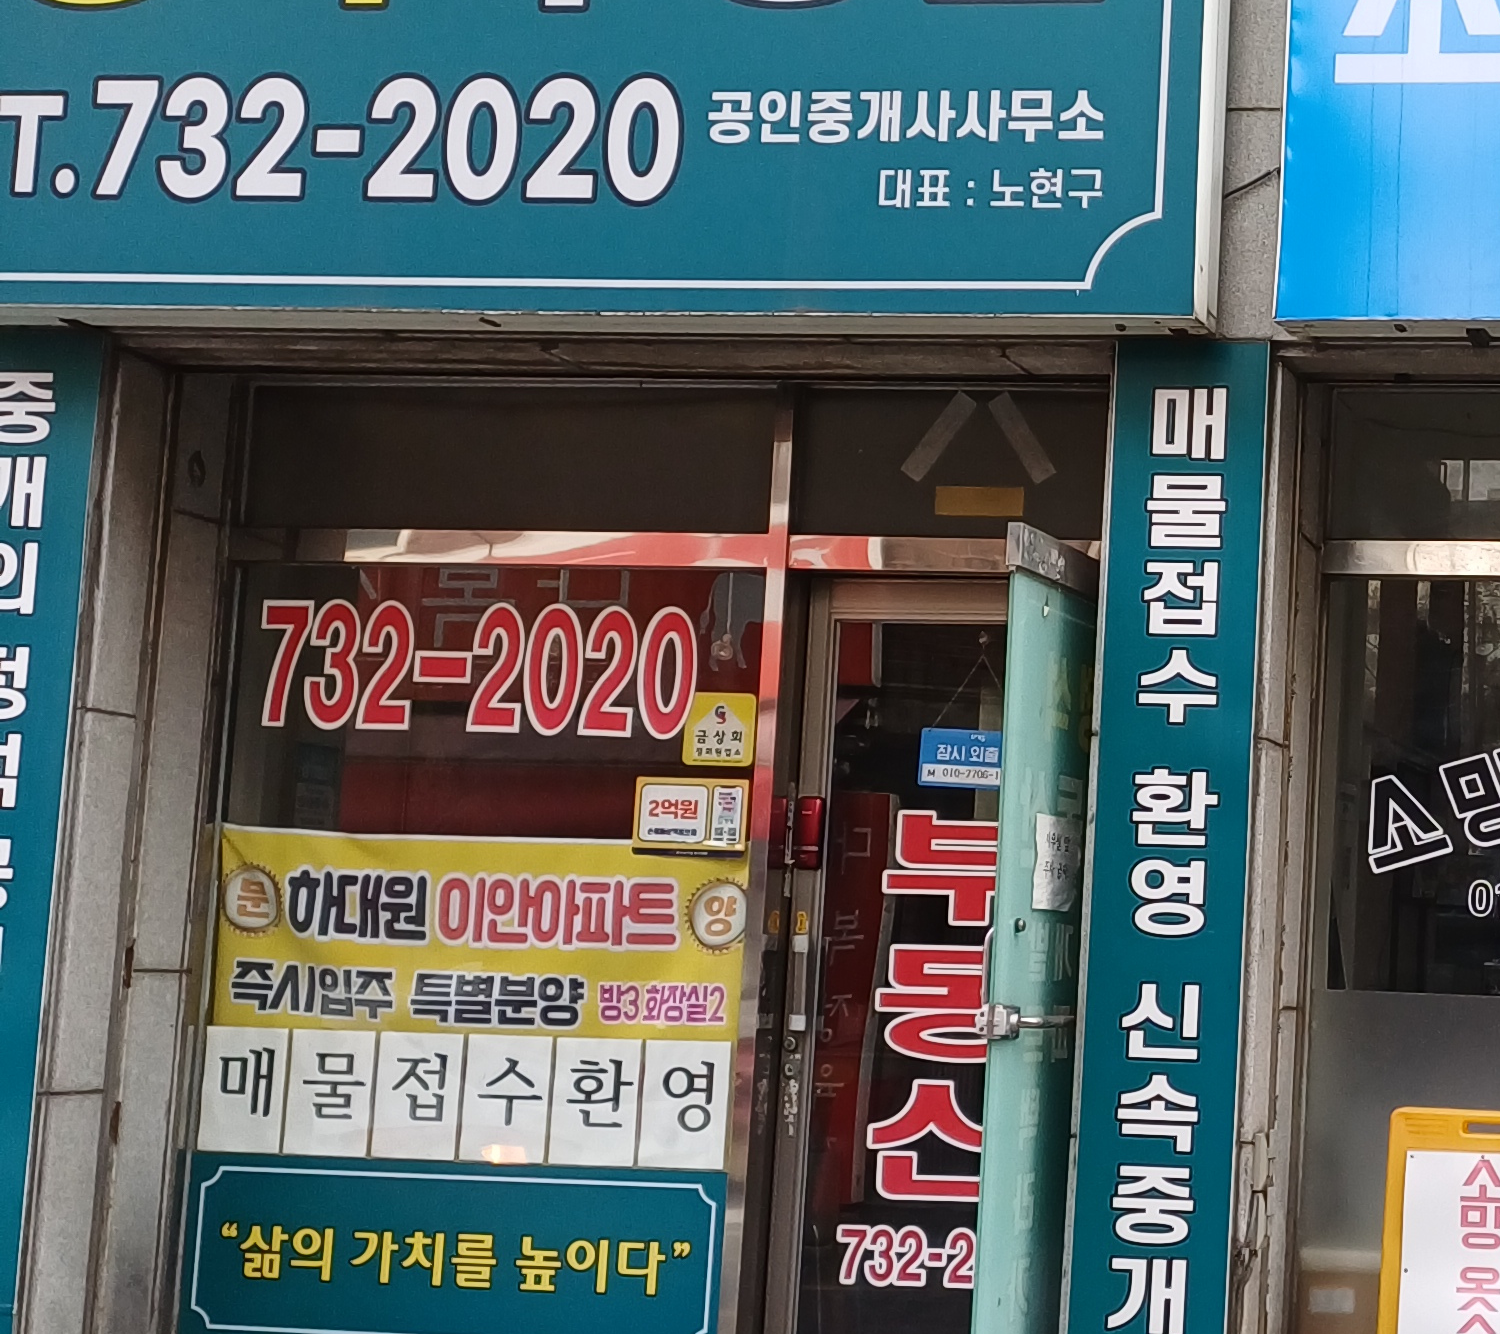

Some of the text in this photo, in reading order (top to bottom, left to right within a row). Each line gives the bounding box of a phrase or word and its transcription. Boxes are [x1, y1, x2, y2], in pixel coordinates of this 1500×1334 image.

[707, 88, 1105, 145] 공인중개사사무소
[877, 168, 951, 210] 대표
[989, 167, 1104, 210] 노현구
[261, 598, 698, 741] 732-2020
[936, 743, 966, 762] 잠시
[648, 799, 699, 820] 2억원
[286, 868, 678, 948] 하대원 이안아파트
[230, 957, 395, 1021] 즉시입주
[410, 972, 586, 1027] 특별분양
[348, 1228, 498, 1290] 가치를
